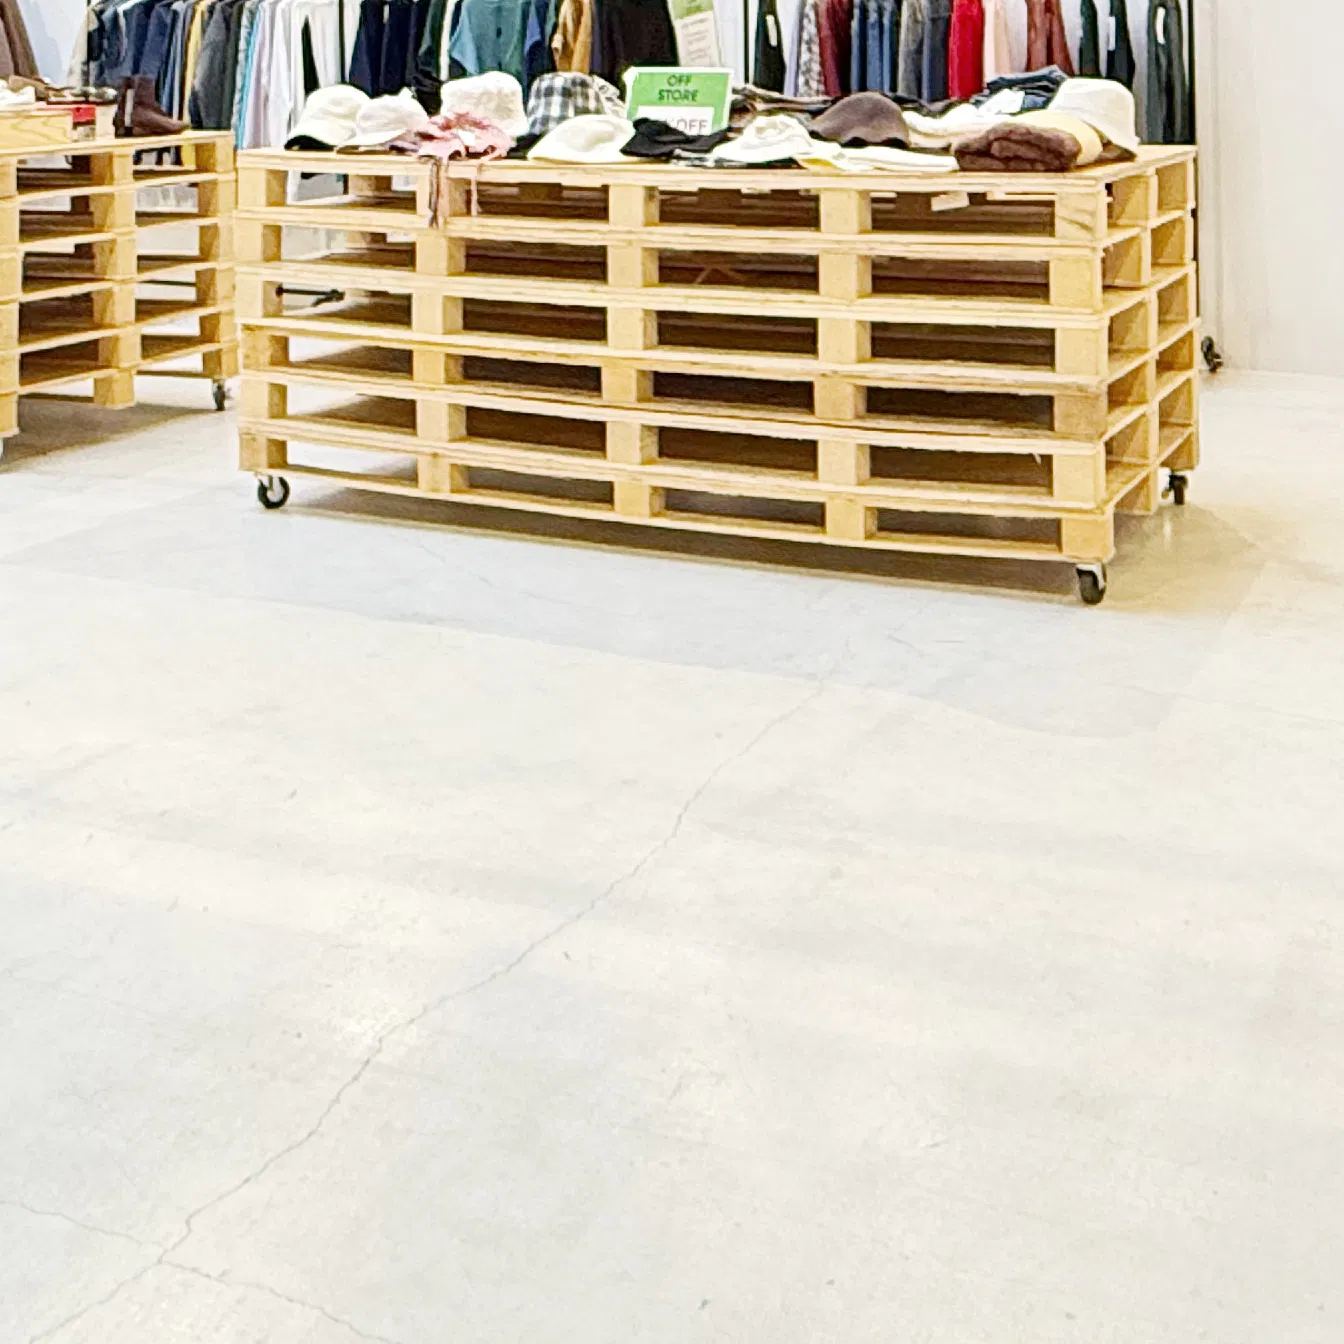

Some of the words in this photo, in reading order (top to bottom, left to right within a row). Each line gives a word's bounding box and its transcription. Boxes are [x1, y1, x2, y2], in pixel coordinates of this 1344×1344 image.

[667, 74, 692, 87] OFF
[657, 89, 699, 102] STORE
[666, 117, 709, 134] OFF
